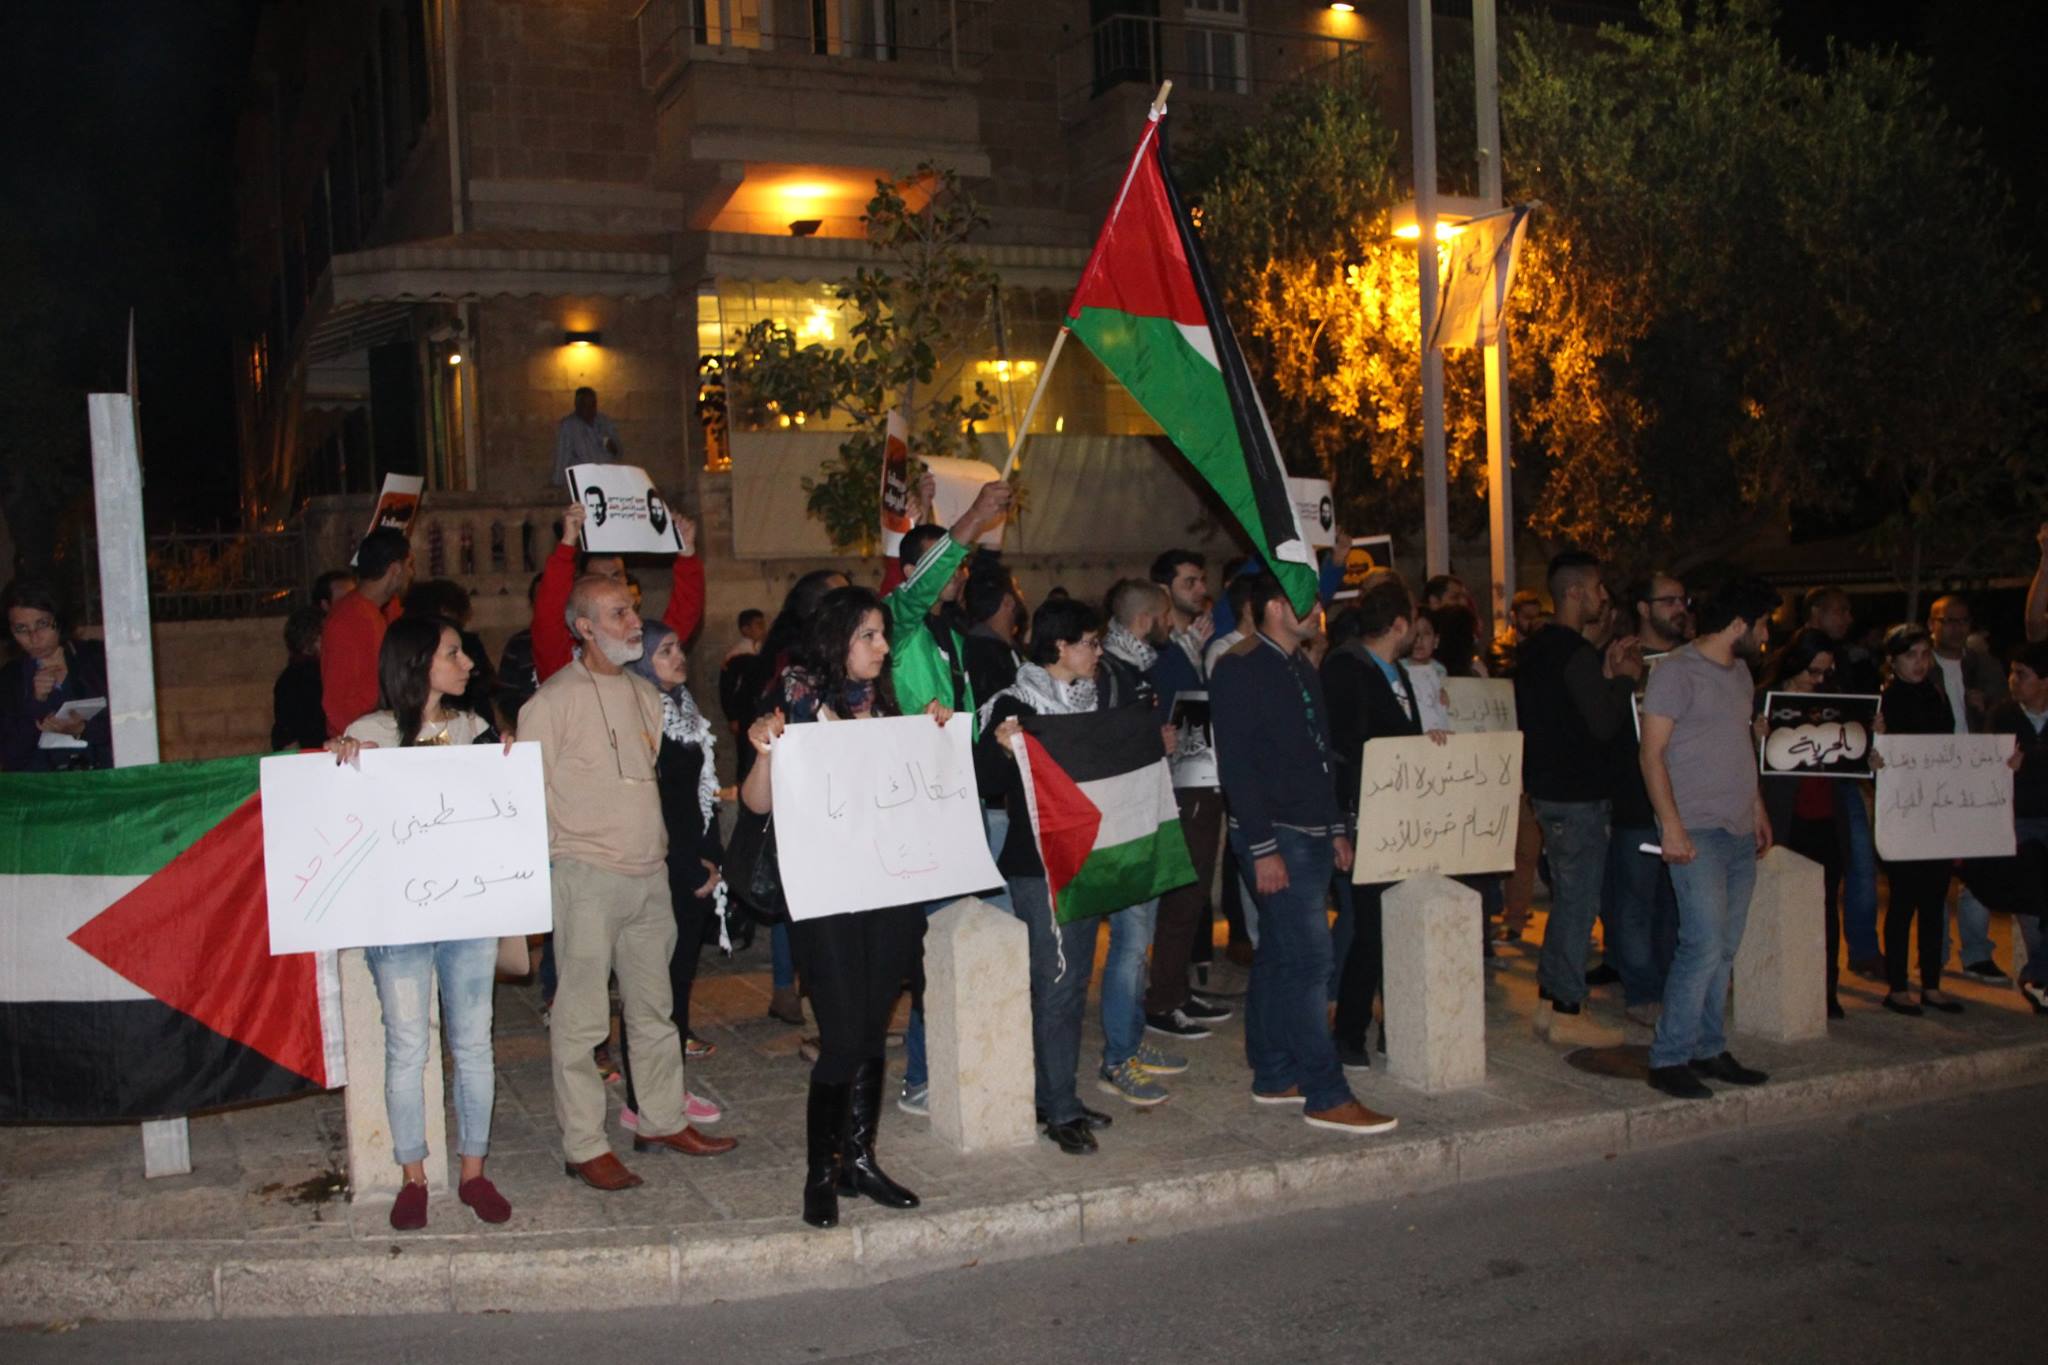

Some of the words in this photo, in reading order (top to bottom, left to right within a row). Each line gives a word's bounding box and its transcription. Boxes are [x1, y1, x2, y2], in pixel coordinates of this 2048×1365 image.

[875, 761, 967, 808] معاك
[1415, 765, 1435, 799] ولا
[1439, 753, 1488, 796] داعش
[1499, 753, 1512, 786] لا
[391, 791, 519, 845] فلسطيني
[826, 772, 848, 820] يا
[1461, 804, 1511, 857] الشام
[294, 816, 363, 901] واحد
[404, 868, 535, 907] سوري
